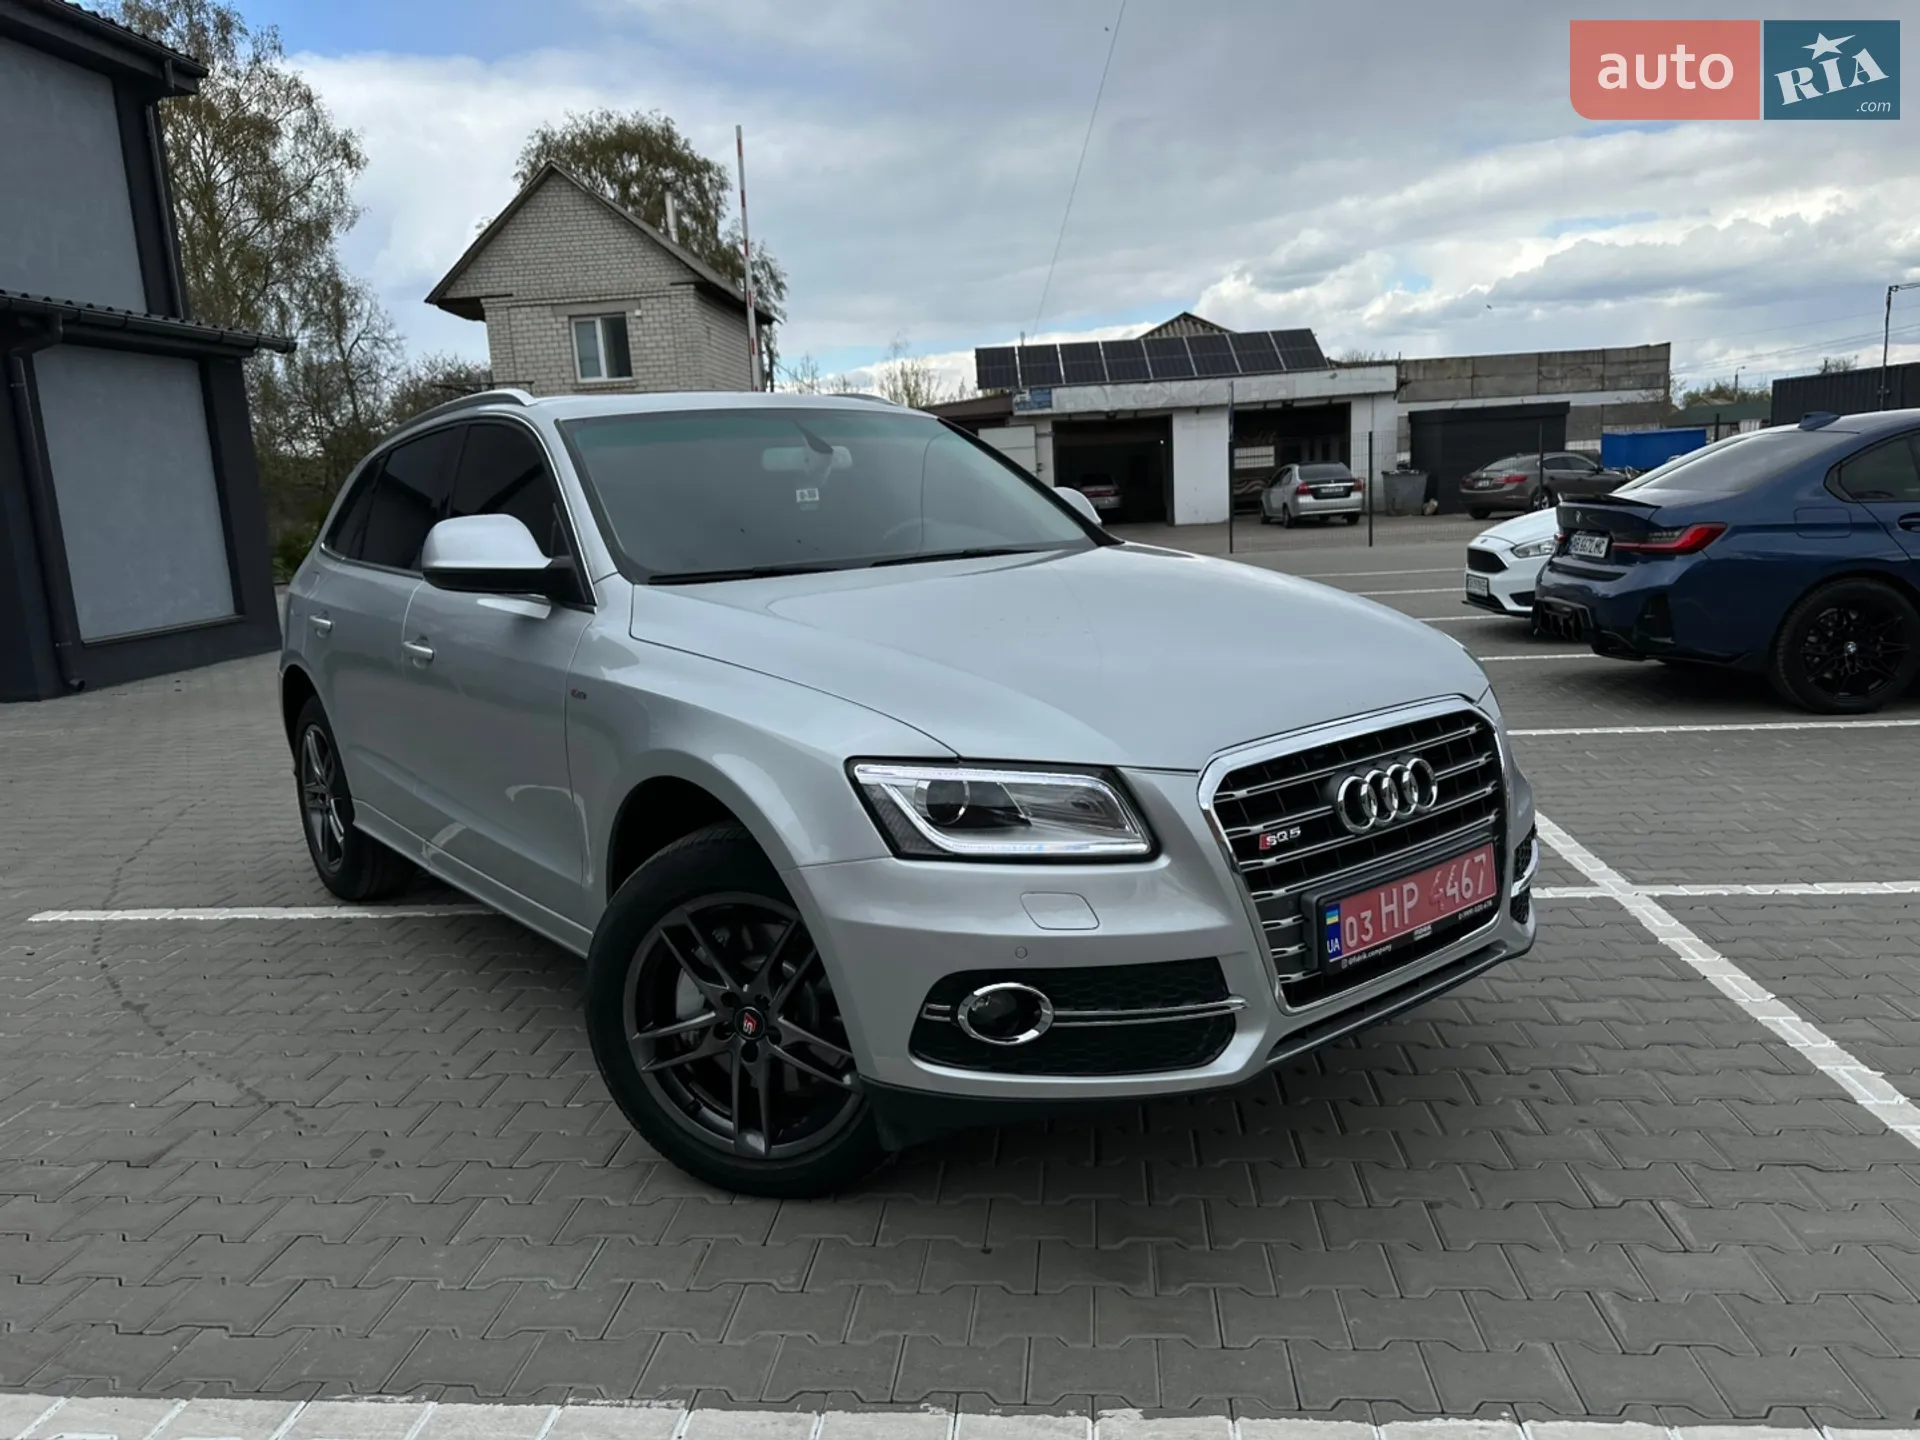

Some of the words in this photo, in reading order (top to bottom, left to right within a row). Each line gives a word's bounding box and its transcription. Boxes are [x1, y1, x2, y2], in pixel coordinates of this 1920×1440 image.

[1266, 826, 1301, 846] SQ5
[1345, 909, 1373, 948] 03
[1379, 882, 1419, 933] HP
[1429, 853, 1487, 911] 4467
[1326, 937, 1341, 954] UA
